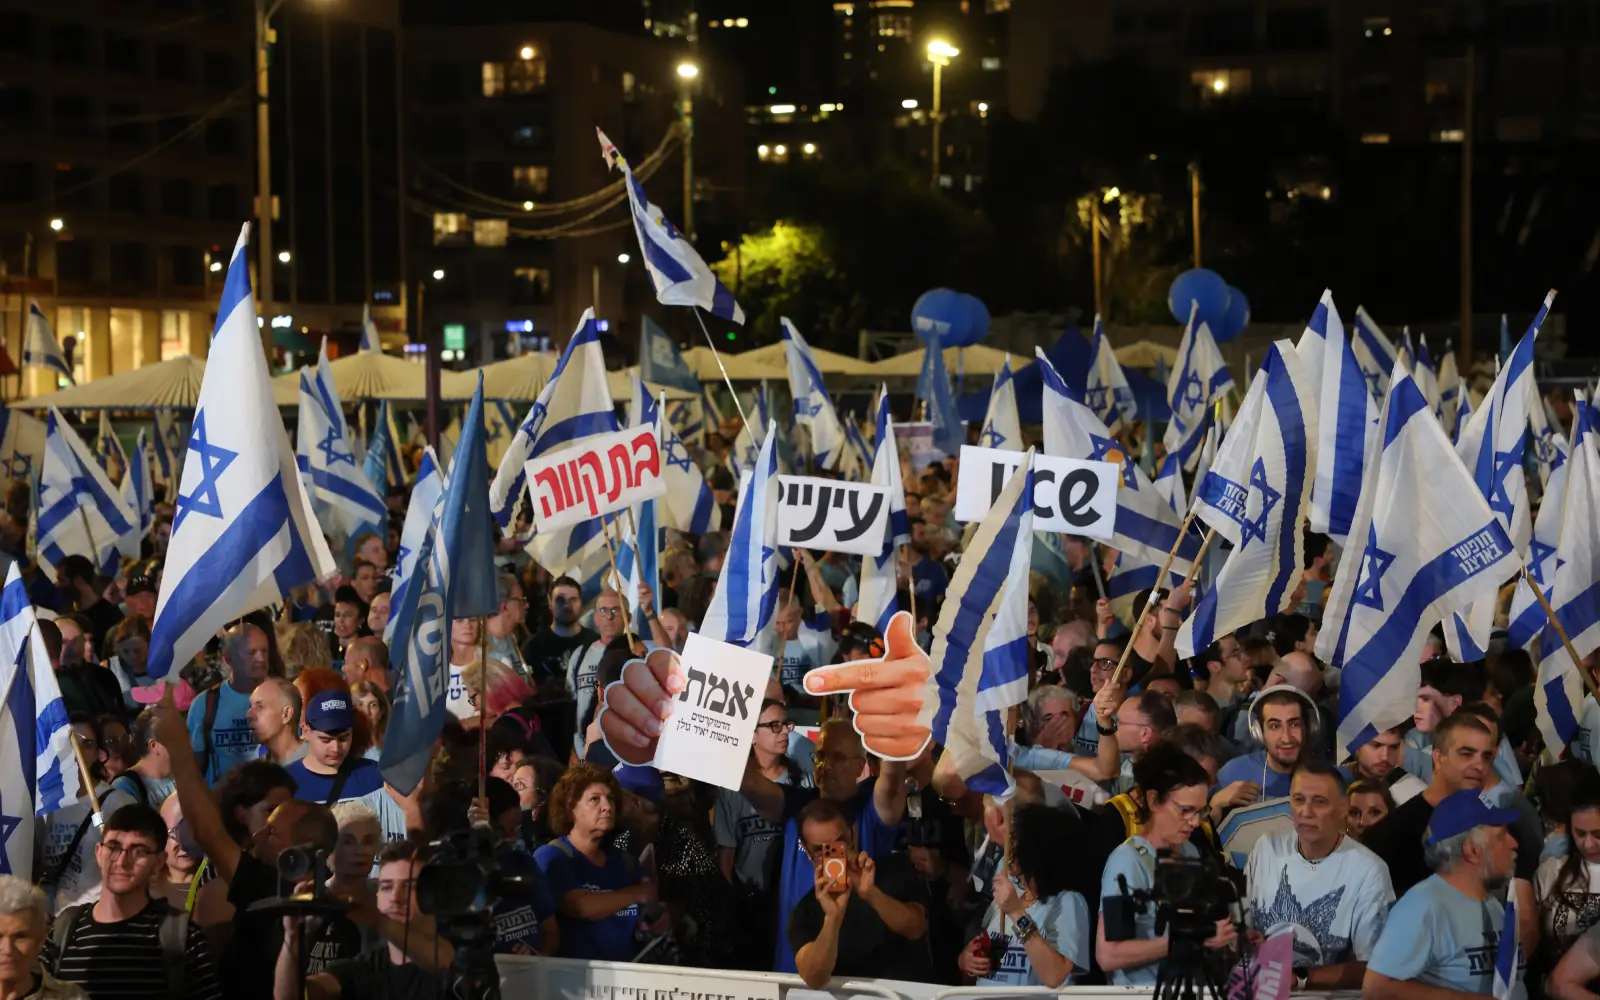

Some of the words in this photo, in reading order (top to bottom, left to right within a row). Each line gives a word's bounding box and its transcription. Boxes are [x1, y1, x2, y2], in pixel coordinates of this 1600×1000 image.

[778, 480, 884, 542] עיניי
[1450, 530, 1494, 561] חופשי
[1458, 542, 1503, 575] בארצנו
[679, 666, 755, 721] אמת
[676, 718, 691, 732] גולן
[691, 712, 731, 731] הדמוקרטים
[693, 724, 709, 737] יאיר
[709, 731, 739, 747] בראשות
[496, 909, 536, 931] הדמוק
[616, 908, 637, 917] בראש
